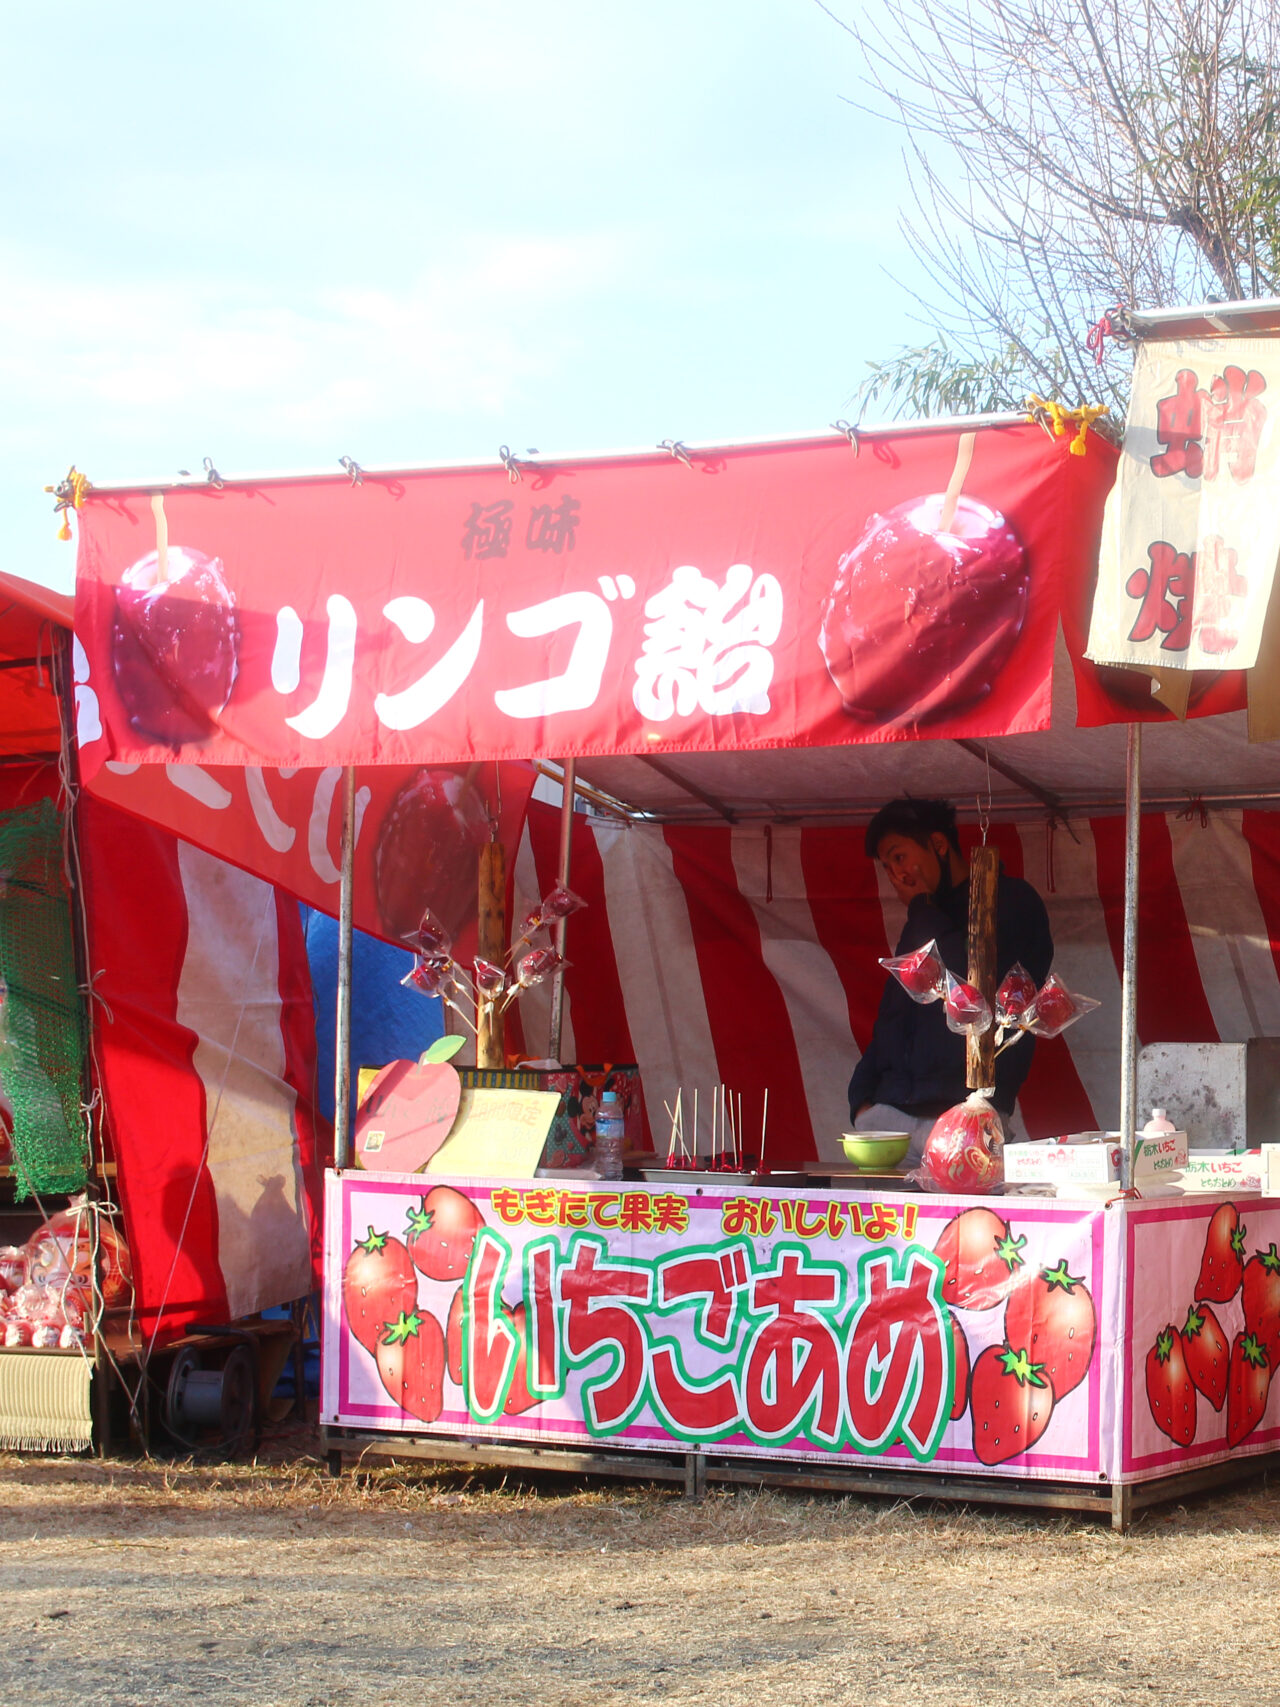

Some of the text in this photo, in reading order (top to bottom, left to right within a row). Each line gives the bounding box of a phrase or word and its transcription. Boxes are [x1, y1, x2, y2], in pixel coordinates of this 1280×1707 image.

[1125, 365, 1268, 654] 蛸焼
[271, 563, 784, 740] リンゴ飴
[491, 1187, 919, 1242] もぎたて果実 おいしいよ!
[1143, 1138, 1176, 1155] 栃木いちご
[463, 1227, 956, 1463] いちごあめ
